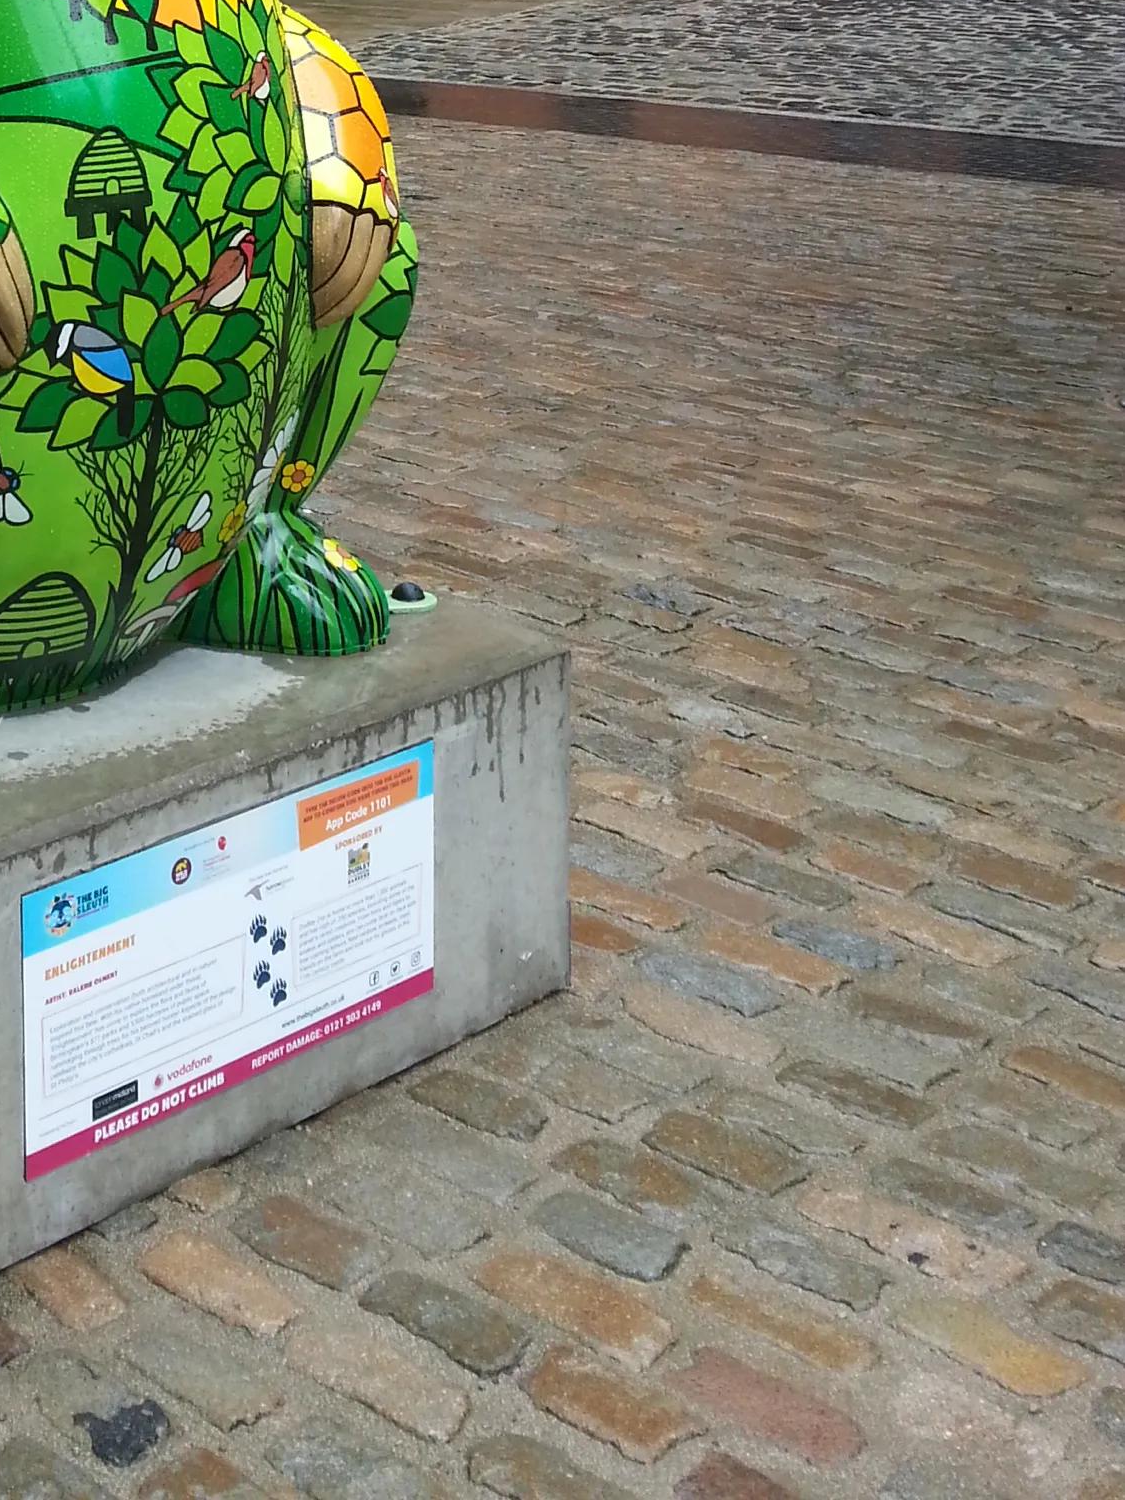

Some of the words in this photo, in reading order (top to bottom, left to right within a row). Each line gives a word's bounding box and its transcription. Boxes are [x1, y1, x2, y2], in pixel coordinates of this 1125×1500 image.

[326, 814, 342, 833] App
[345, 804, 366, 823] Code
[370, 795, 390, 812] 1101
[77, 892, 91, 905] THE
[93, 885, 107, 898] BIG
[77, 895, 108, 915] SLEUTH
[45, 933, 135, 981] ENLIGHTENMENT
[251, 1045, 283, 1070] REPORT
[286, 1027, 322, 1053] DAMAGE:
[323, 1017, 343, 1036] 0121
[345, 1009, 360, 1025] 303
[361, 999, 381, 1018] 4149
[167, 1051, 212, 1082] vodafone
[94, 1111, 138, 1143] PLEASE
[141, 1102, 157, 1121] DO
[161, 1088, 185, 1111] NOT
[188, 1070, 224, 1099] CLIMB
